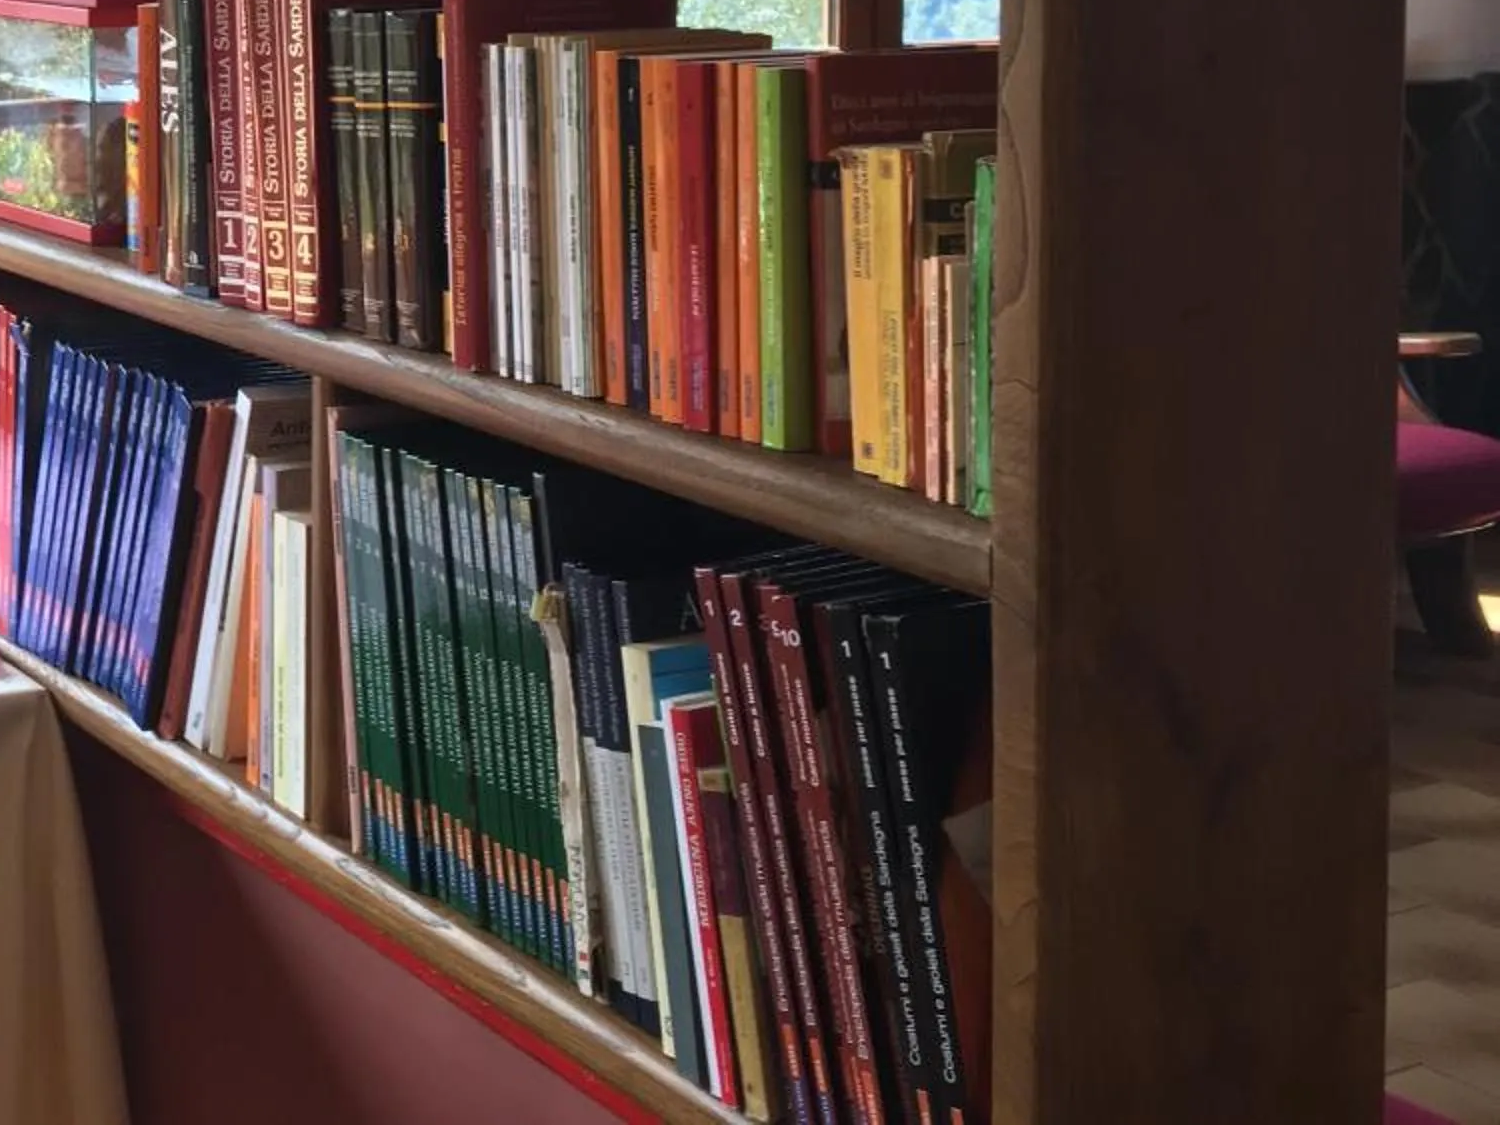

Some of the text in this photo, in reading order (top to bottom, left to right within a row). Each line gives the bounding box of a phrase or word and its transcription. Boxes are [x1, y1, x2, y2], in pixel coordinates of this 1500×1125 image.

[159, 26, 182, 135] ALES
[216, 56, 234, 111] DELLA
[259, 62, 274, 118] DELLA
[292, 64, 306, 120] DELLA
[218, 117, 237, 185] STORIA
[263, 125, 279, 194] STORIA
[291, 127, 309, 197] STORIA
[223, 219, 237, 248] 1
[247, 225, 257, 254] 2
[269, 230, 285, 260] 3
[297, 234, 312, 265] 4
[704, 599, 714, 617] 1
[730, 609, 742, 627] 2
[782, 629, 801, 647] 10
[841, 639, 852, 658] 1
[879, 651, 891, 670] 1
[847, 673, 875, 788] paese per paese
[886, 687, 914, 802] paese per paese
[682, 777, 698, 827] ANNO
[867, 809, 892, 888] Sardegna
[904, 824, 929, 903] Sardegna
[881, 889, 898, 929] della
[918, 905, 935, 943] della
[898, 981, 909, 992] e
[934, 997, 945, 1009] e
[898, 996, 922, 1067] Costumi
[935, 1013, 957, 1084] Costumi
